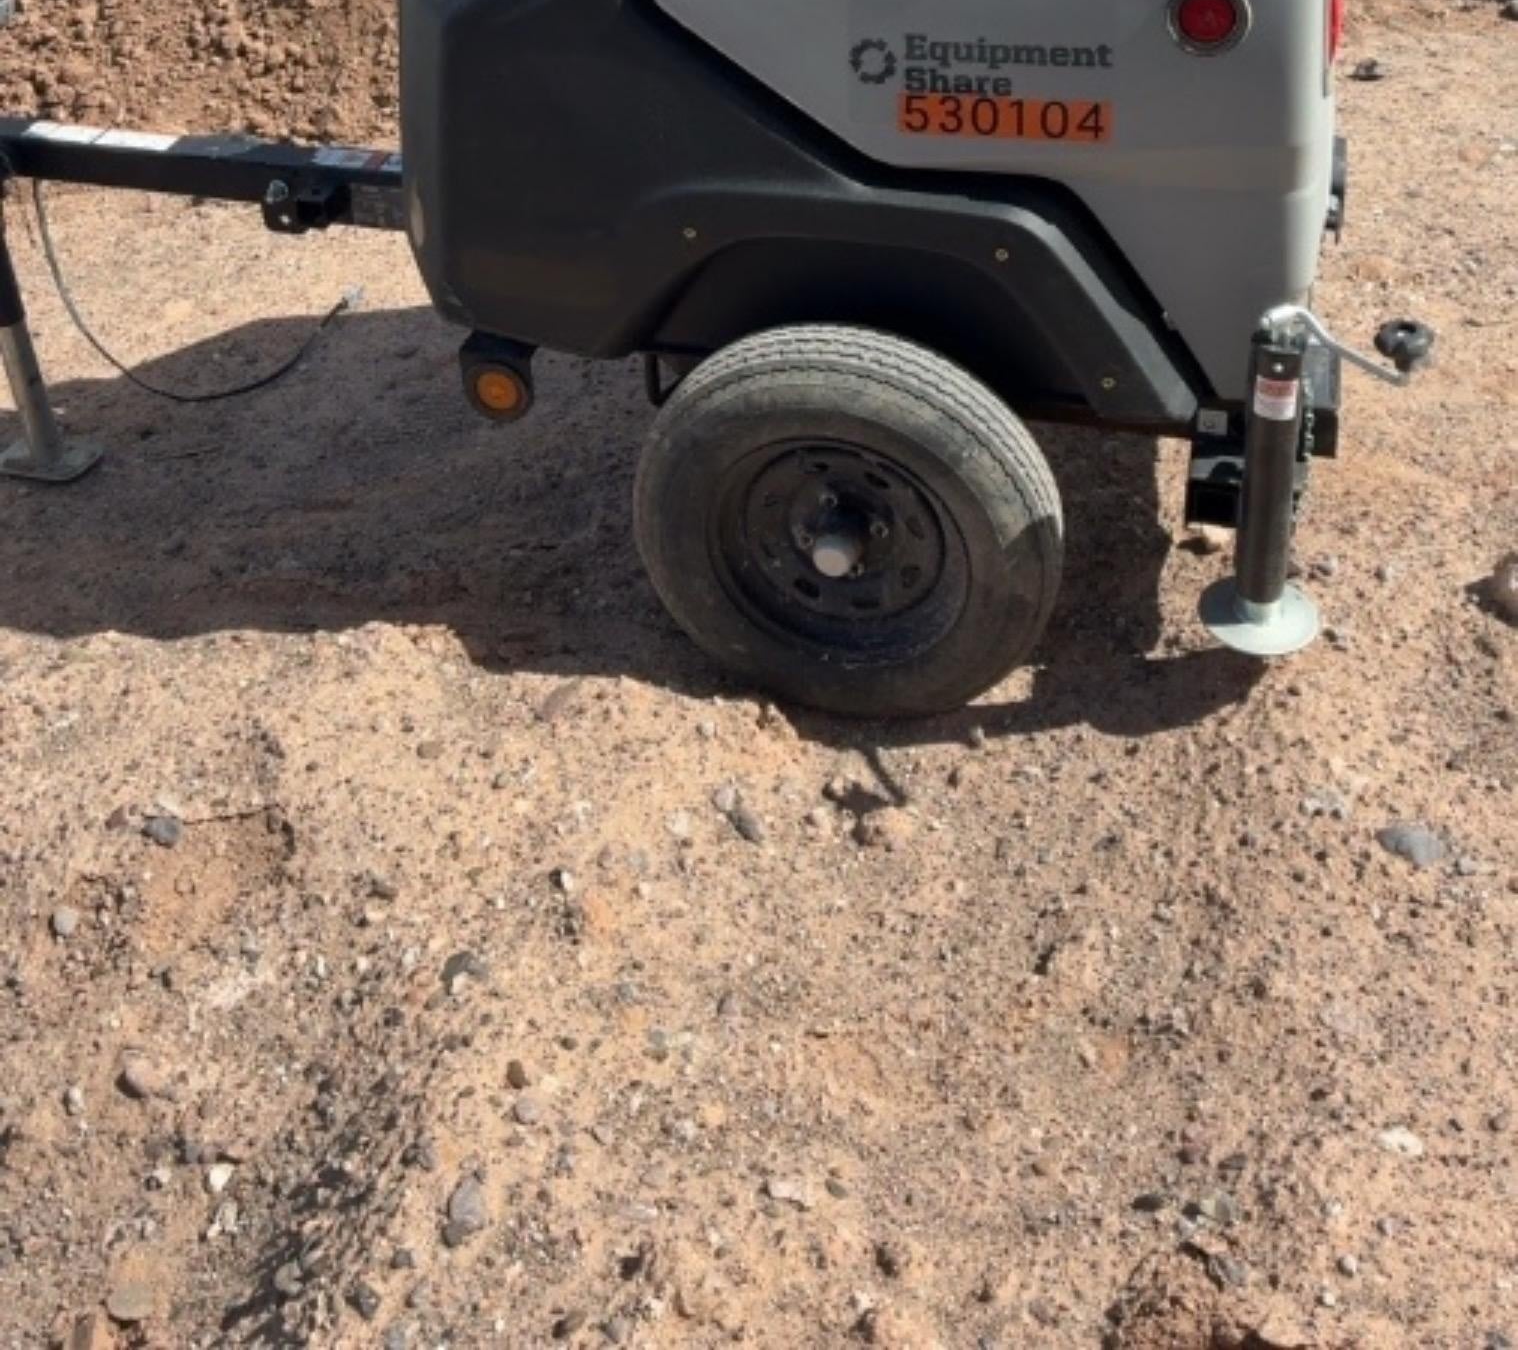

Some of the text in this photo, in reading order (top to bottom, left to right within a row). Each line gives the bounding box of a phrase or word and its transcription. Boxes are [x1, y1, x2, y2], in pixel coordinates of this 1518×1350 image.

[905, 34, 1113, 69] Equipment
[905, 67, 1013, 97] Share
[904, 95, 1105, 139] 530104
